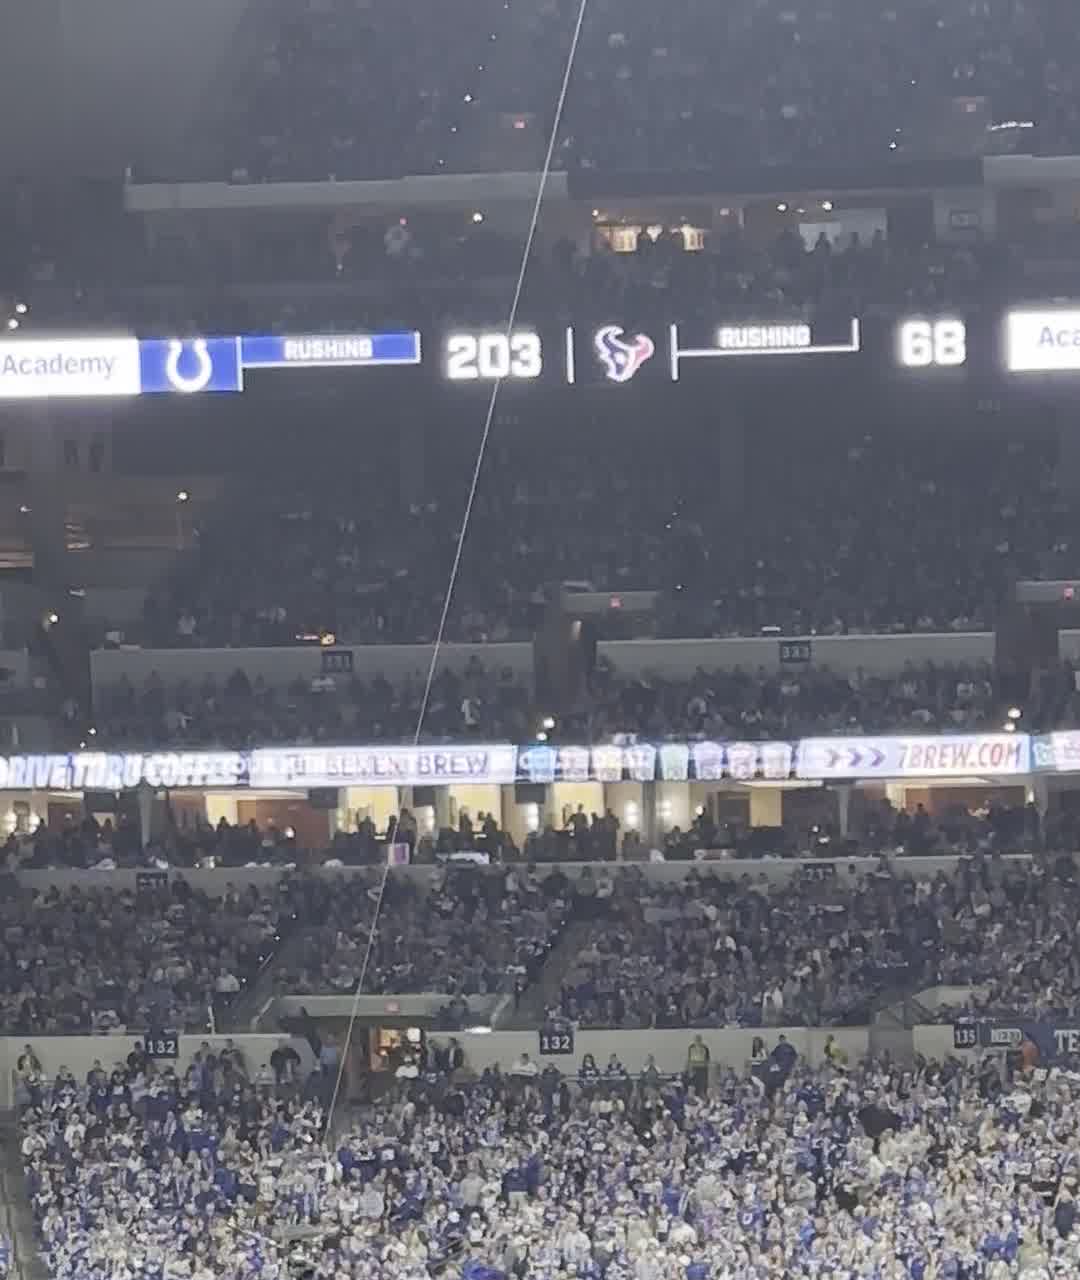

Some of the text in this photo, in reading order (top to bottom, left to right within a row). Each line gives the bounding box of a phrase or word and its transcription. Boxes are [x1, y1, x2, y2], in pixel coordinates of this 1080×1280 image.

[283, 338, 373, 361] RUSHING
[718, 325, 811, 348] RUSHING
[900, 320, 966, 367] 68
[2, 340, 117, 377] Academy
[447, 334, 541, 379] 203
[416, 751, 489, 777] BREW
[542, 1035, 570, 1050] 132
